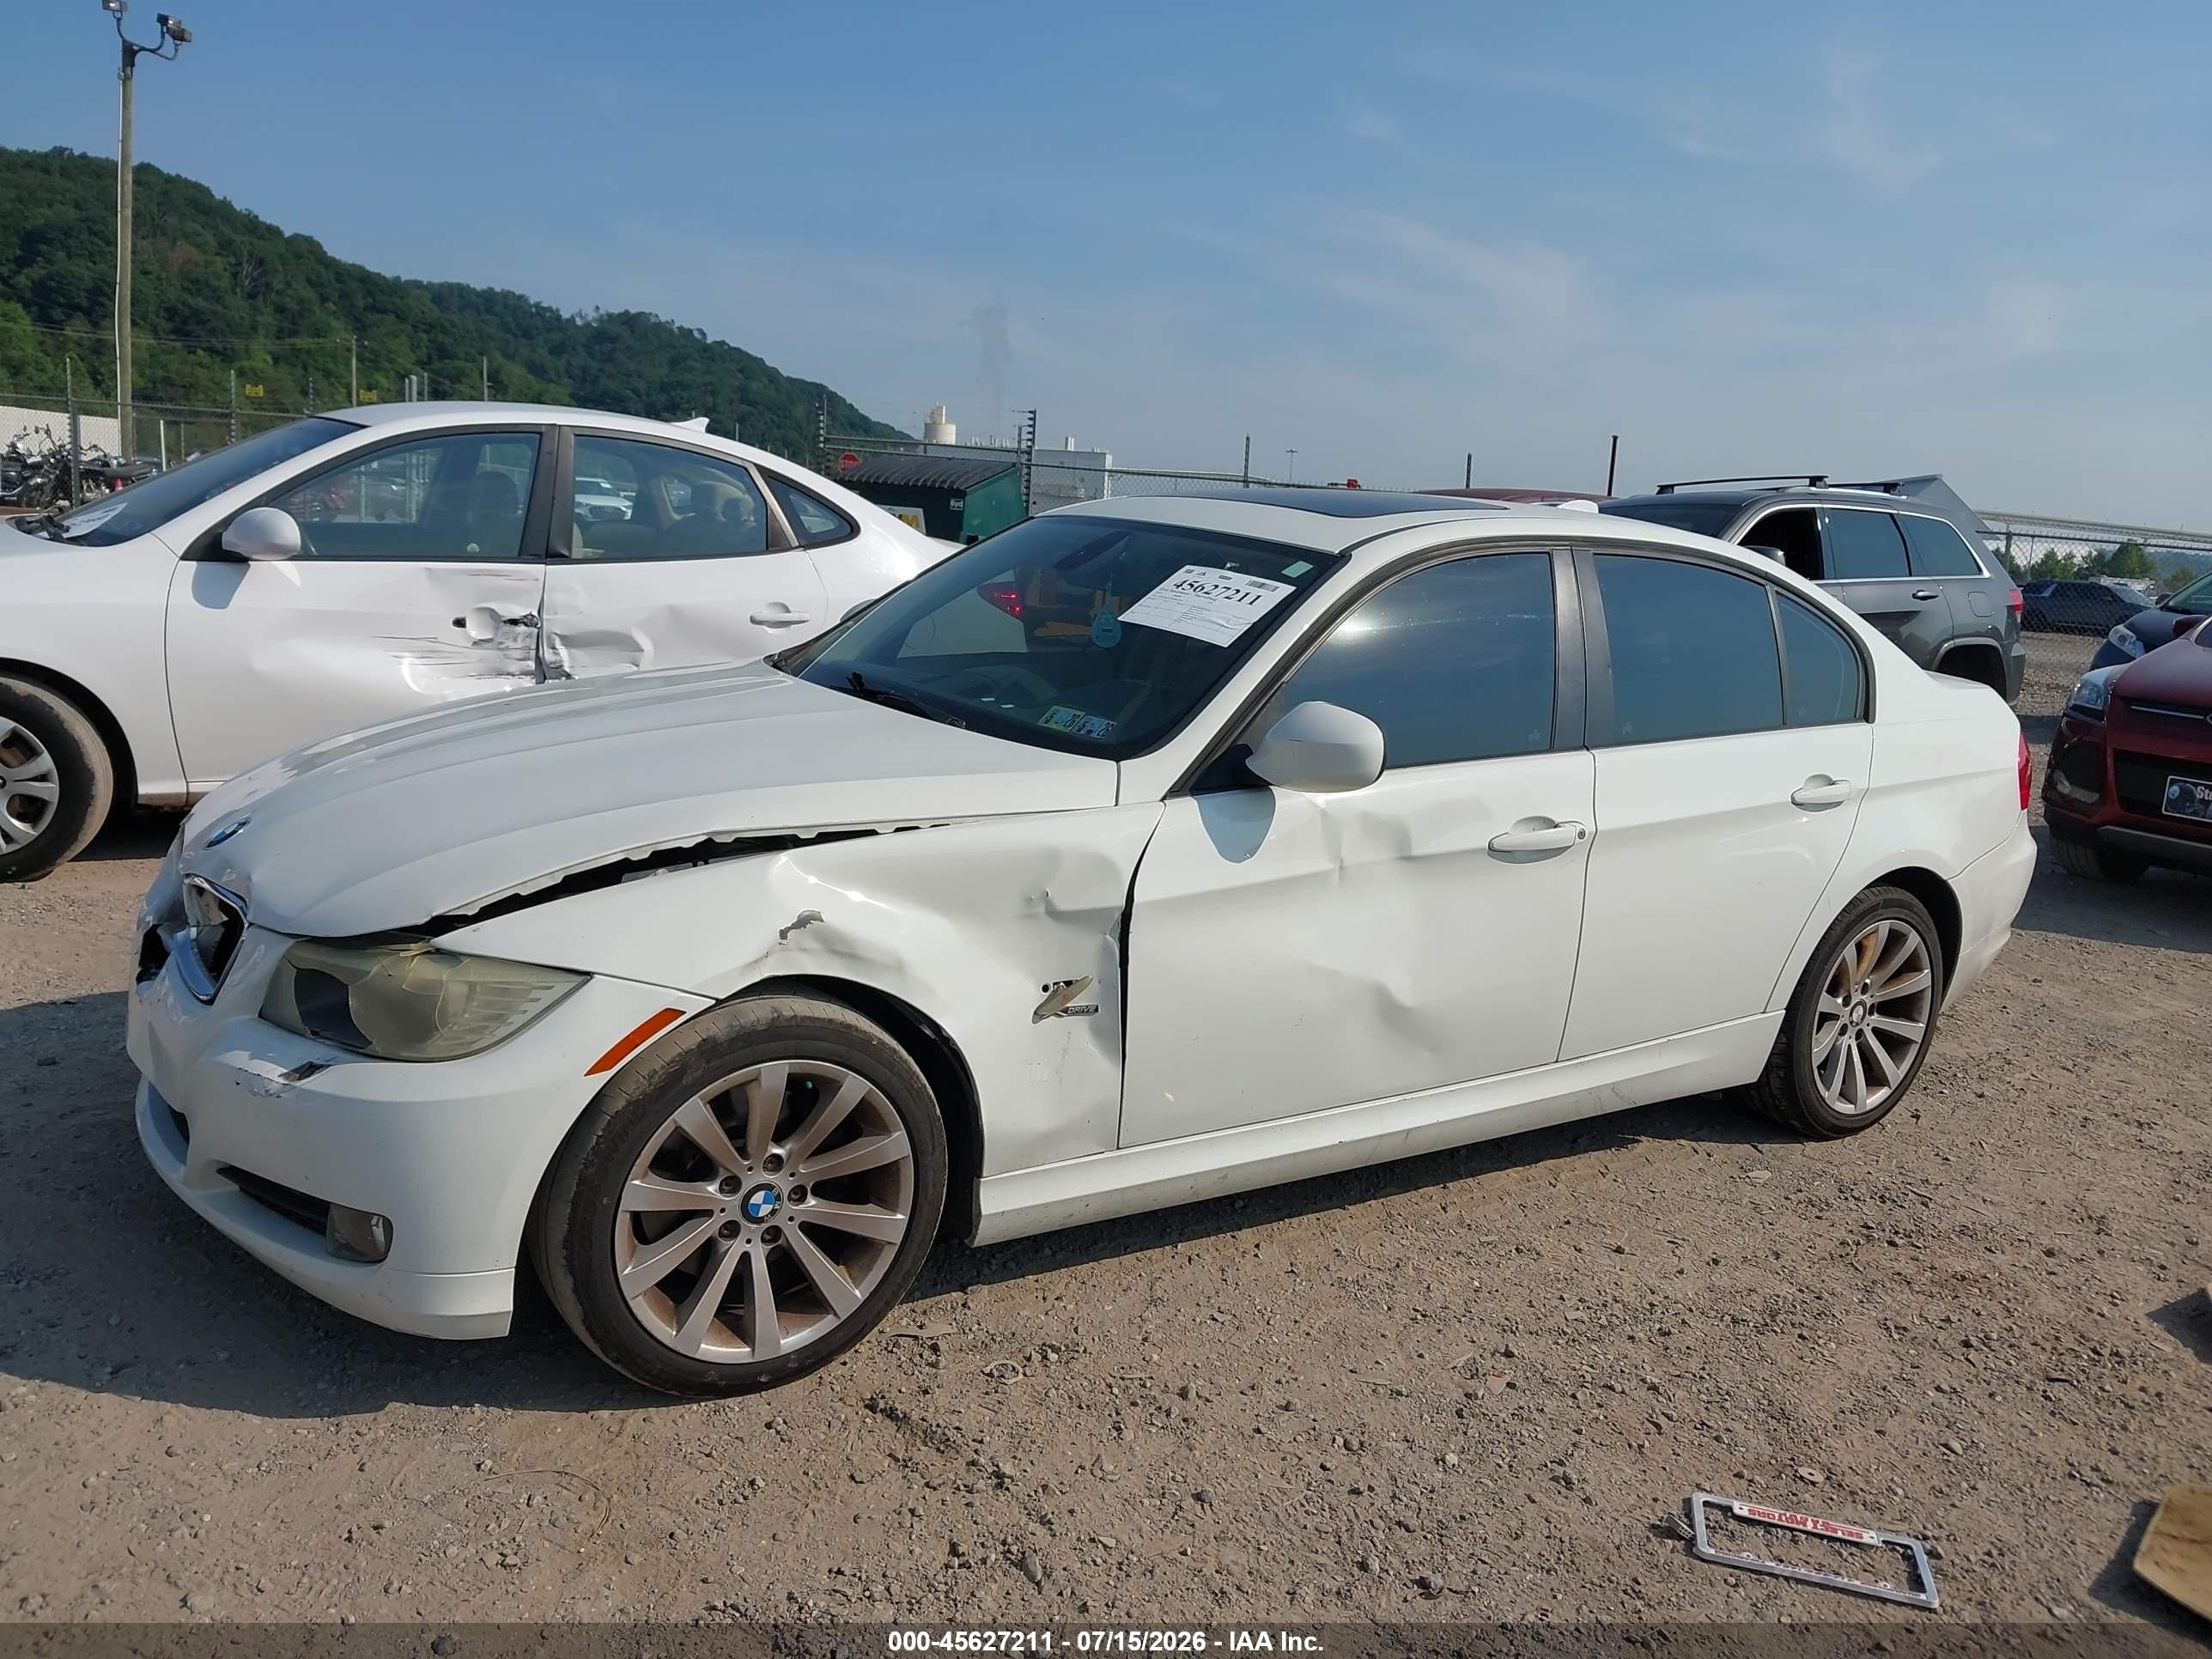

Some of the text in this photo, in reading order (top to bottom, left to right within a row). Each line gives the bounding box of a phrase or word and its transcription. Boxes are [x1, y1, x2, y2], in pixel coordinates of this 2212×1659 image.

[1173, 579, 1263, 606] 45627211
[1063, 714, 1081, 728] 26
[1097, 722, 1115, 737] 26
[1067, 1006, 1097, 1014] DRIVE
